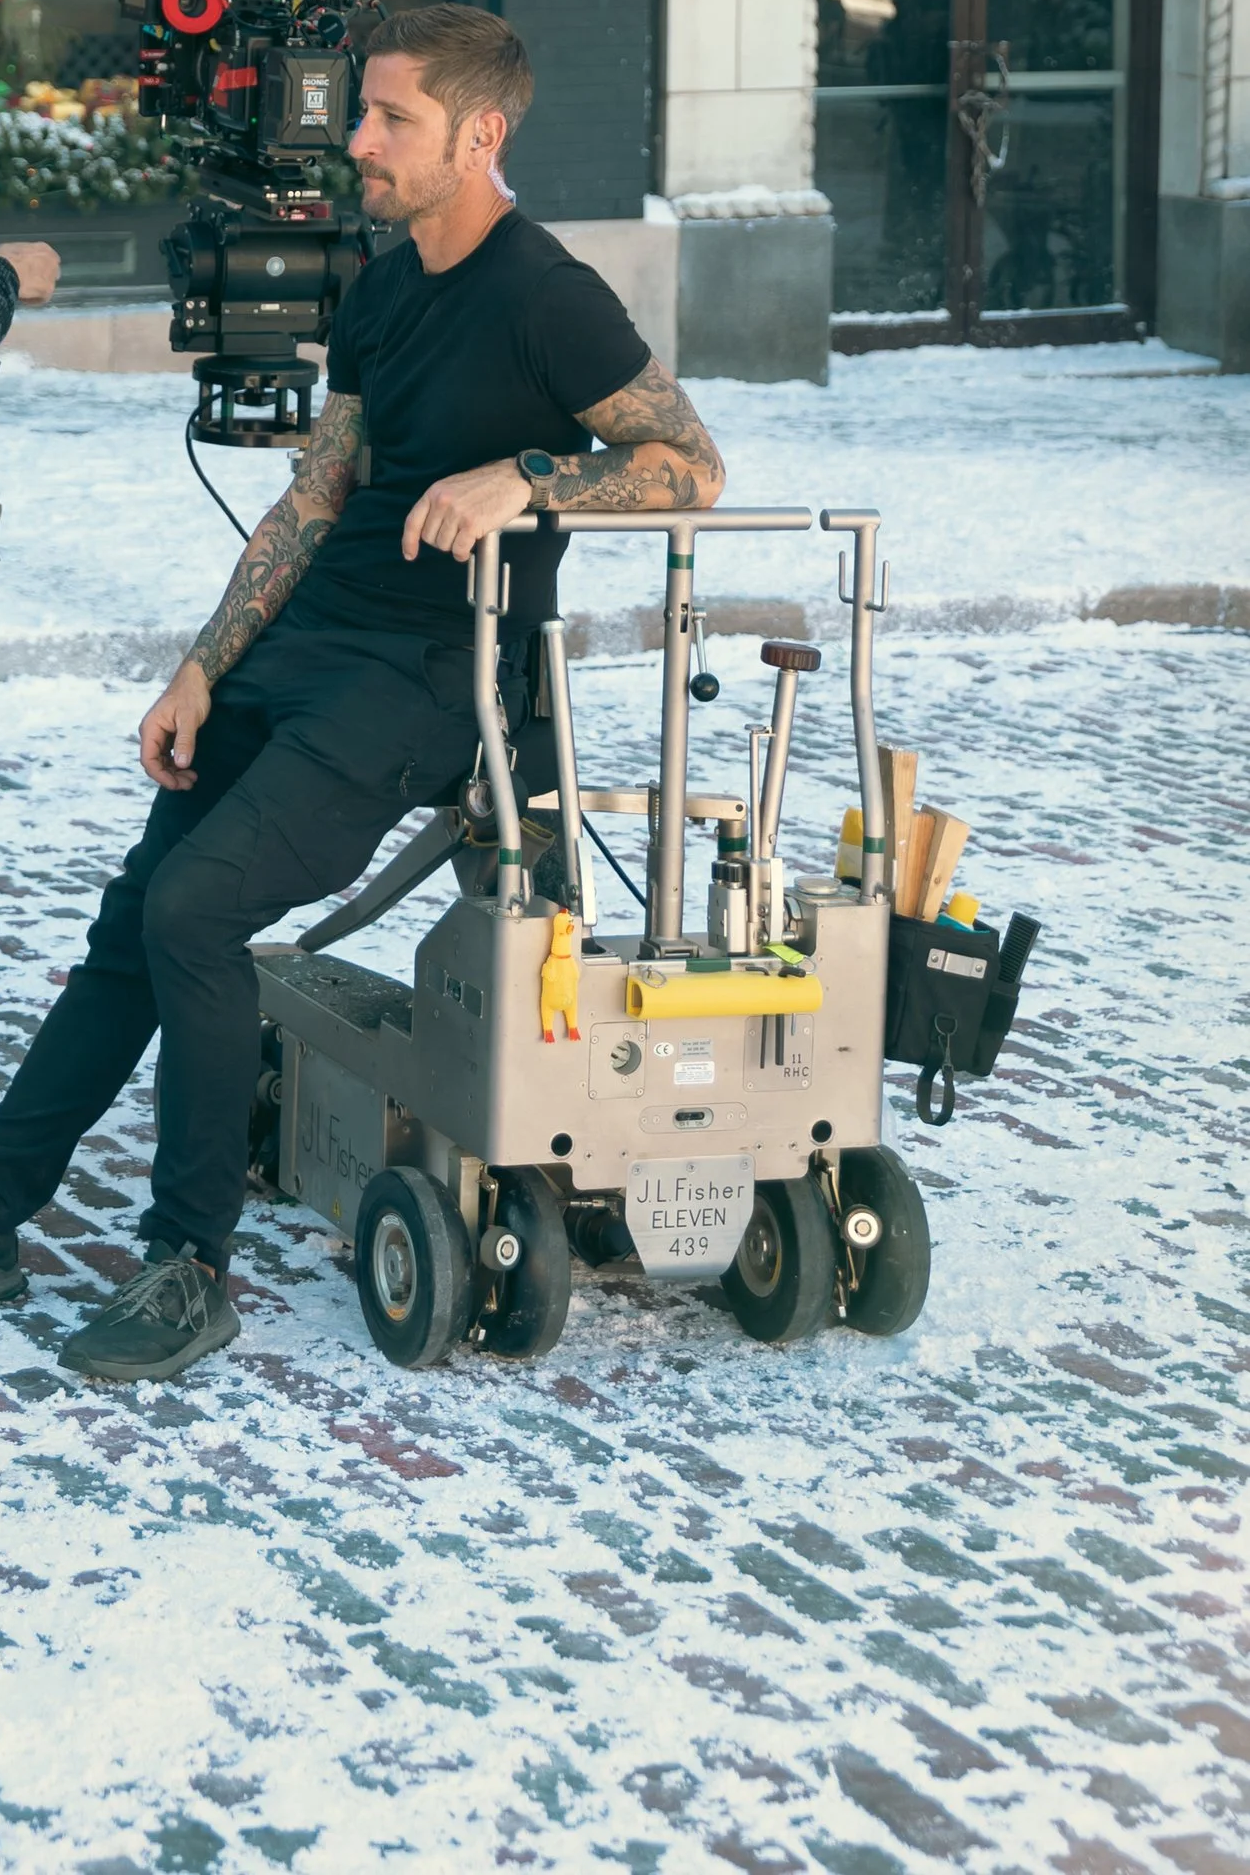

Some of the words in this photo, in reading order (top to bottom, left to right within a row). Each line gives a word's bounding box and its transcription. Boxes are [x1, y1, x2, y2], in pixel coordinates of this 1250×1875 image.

[302, 78, 330, 86] DIONIC
[309, 93, 321, 103] XT
[792, 1053, 802, 1064] 11
[783, 1066, 810, 1078] RHC
[652, 1207, 726, 1229] ELEVEN
[668, 1236, 709, 1257] 439
